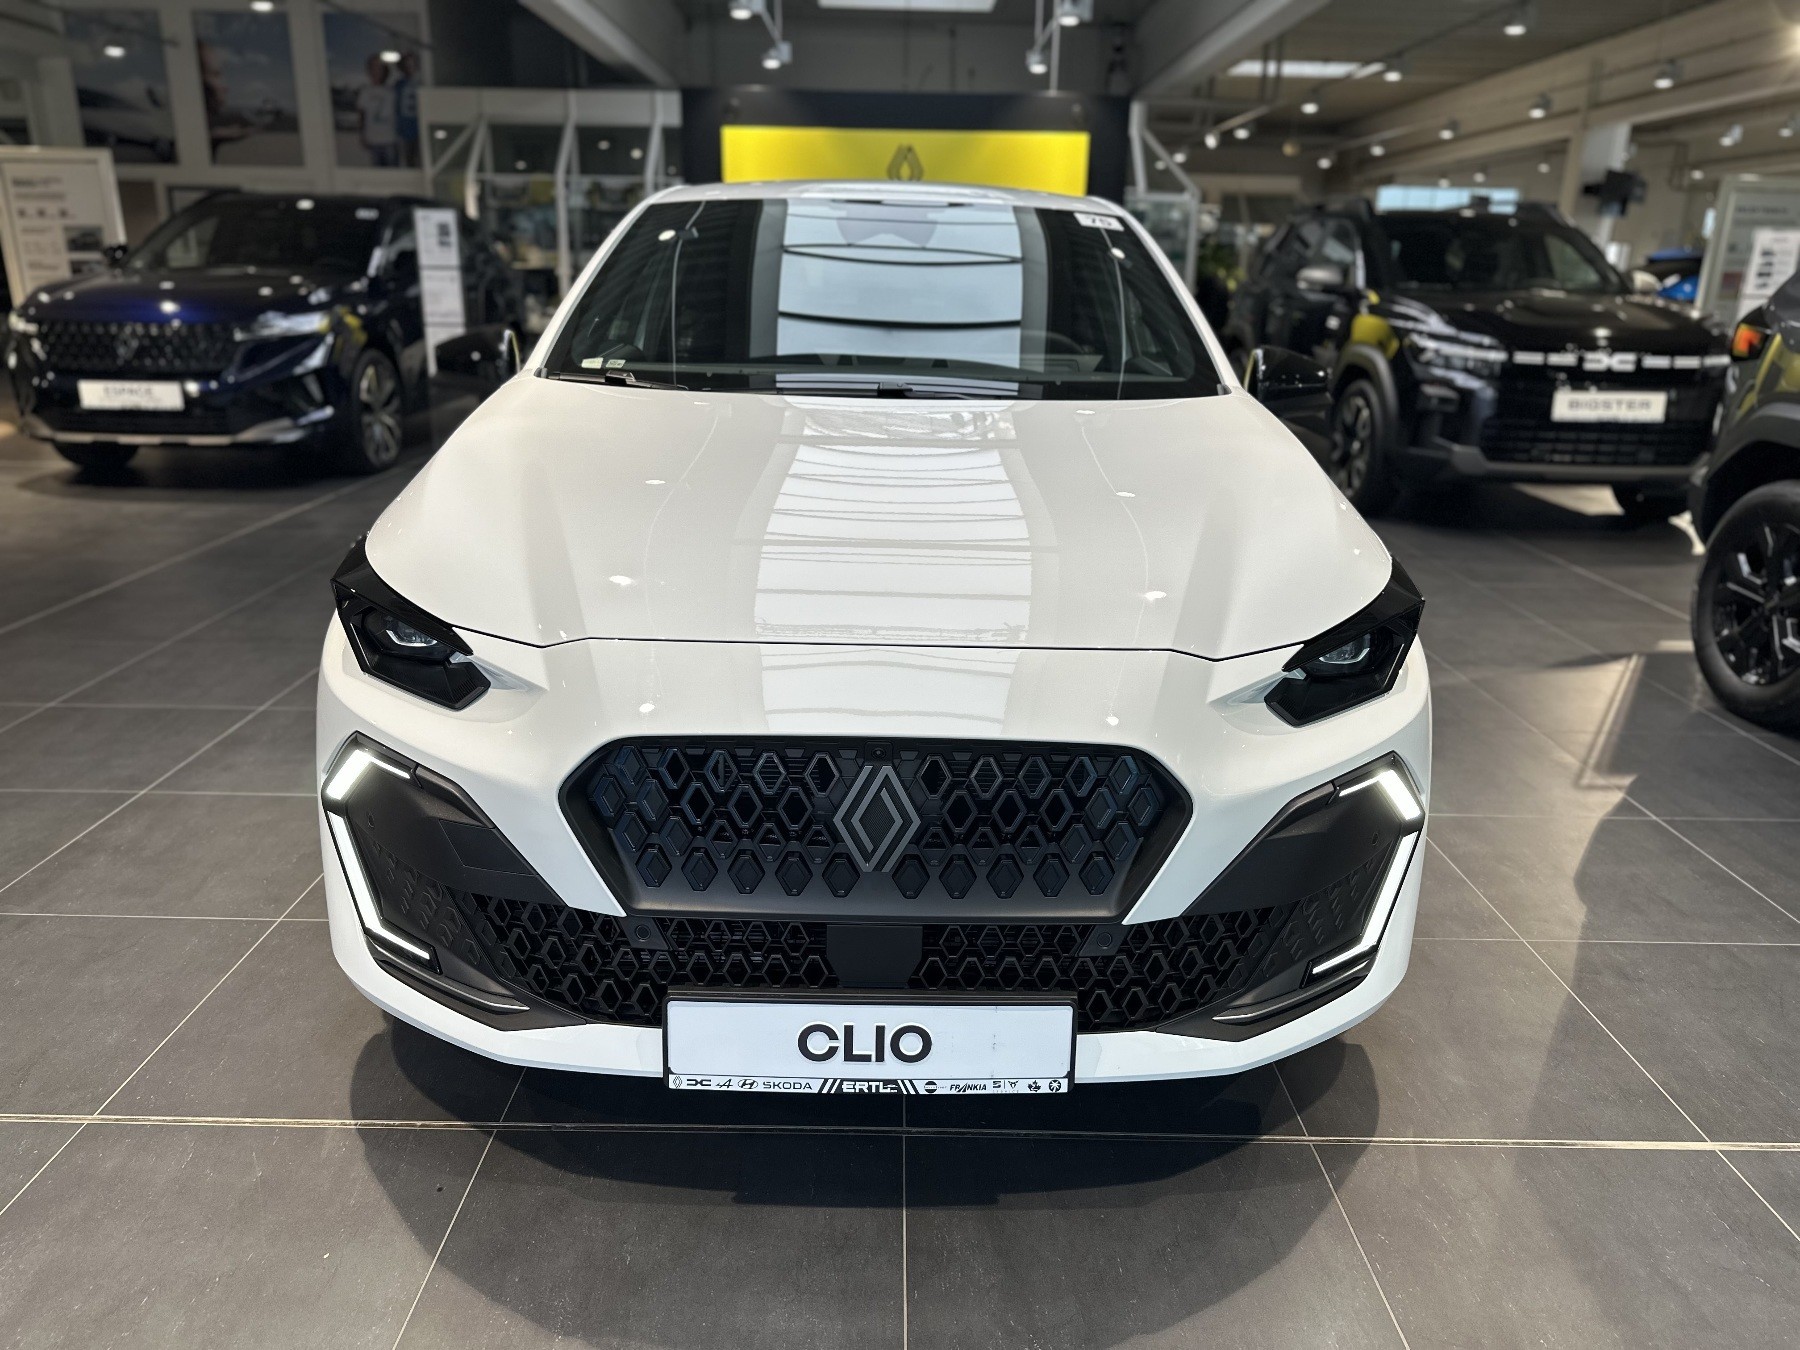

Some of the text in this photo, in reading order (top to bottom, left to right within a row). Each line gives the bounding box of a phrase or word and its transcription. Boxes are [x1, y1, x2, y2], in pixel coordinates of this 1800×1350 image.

[1567, 398, 1652, 411] BIGSTER
[797, 1023, 933, 1063] CLIO
[762, 1081, 813, 1090] SKODA
[949, 1082, 987, 1093] FRANKIA
